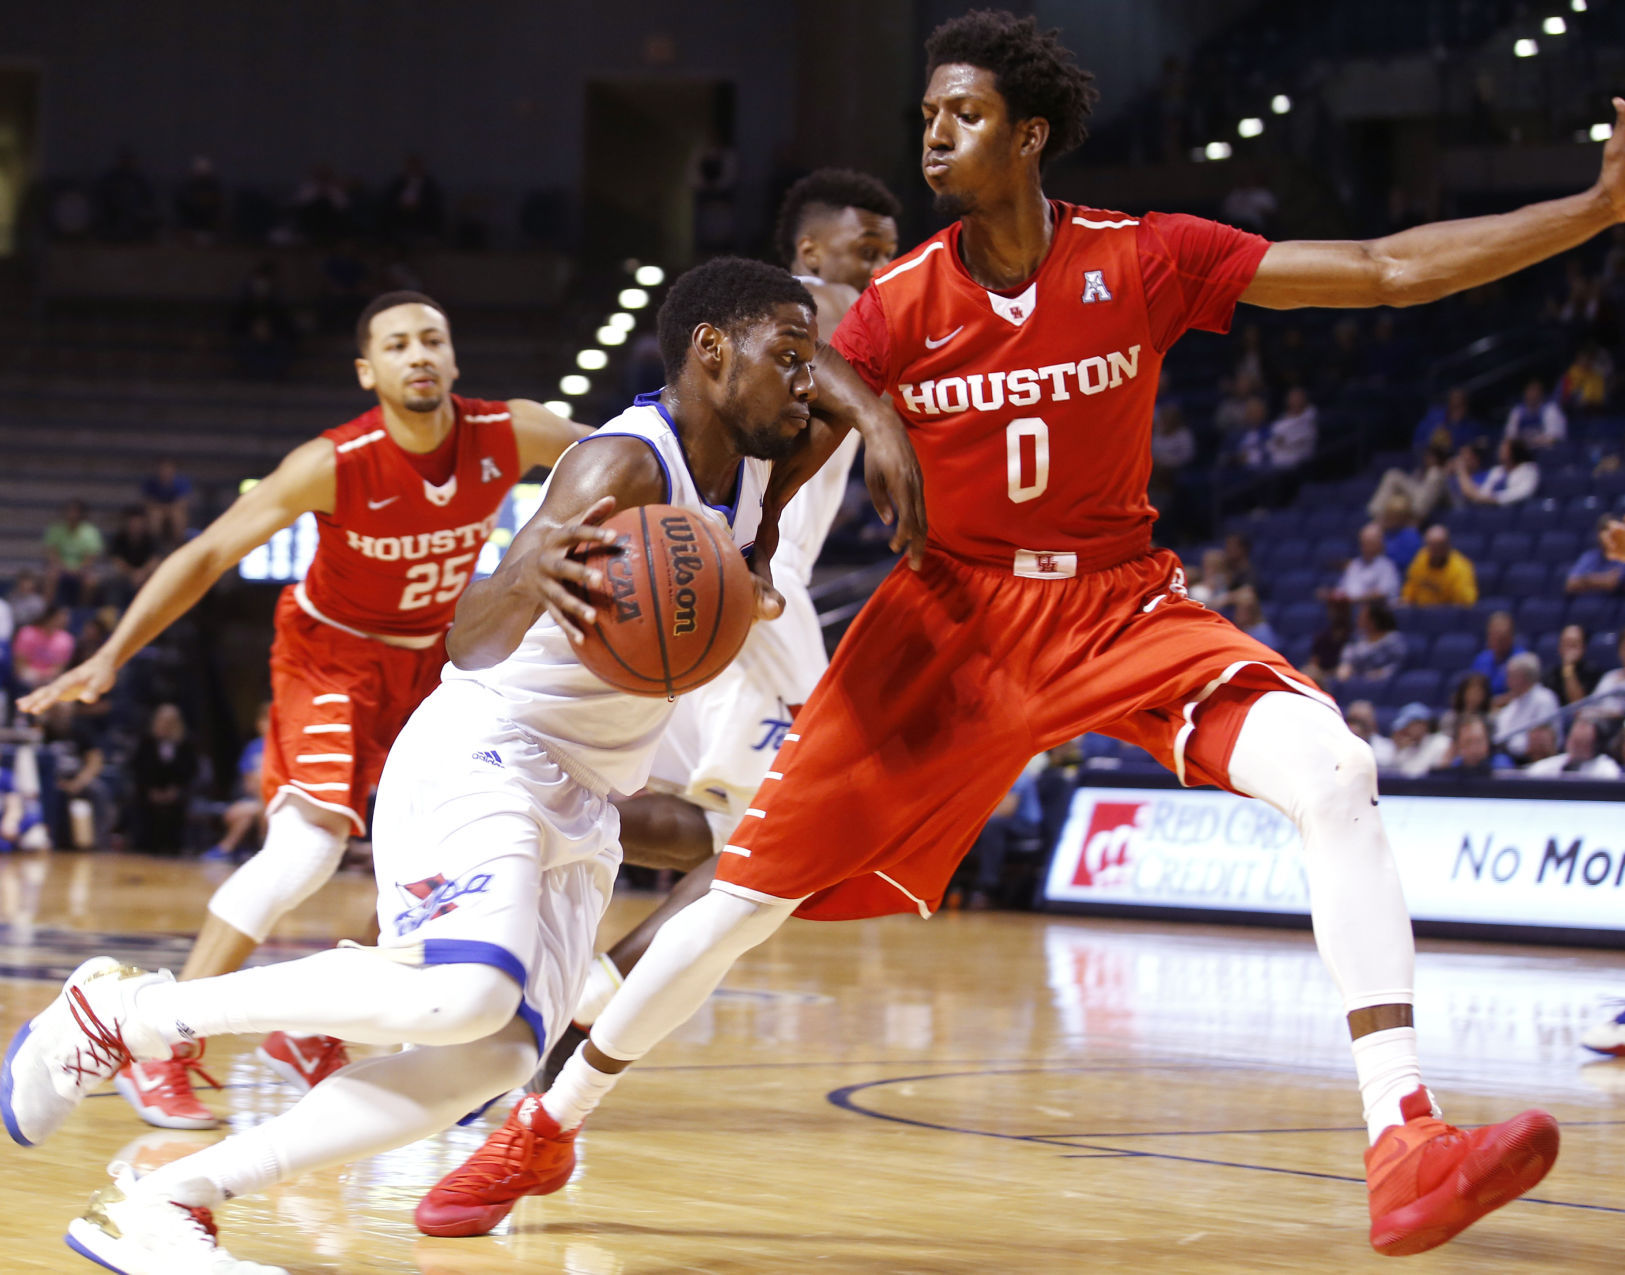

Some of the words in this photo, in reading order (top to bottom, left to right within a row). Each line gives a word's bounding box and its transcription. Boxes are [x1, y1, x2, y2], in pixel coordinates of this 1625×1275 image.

[899, 344, 1142, 415] HOUSTON
[1006, 417, 1050, 504] 0
[399, 553, 475, 611] 25
[660, 516, 704, 637] Wilson
[1451, 831, 1521, 883] No
